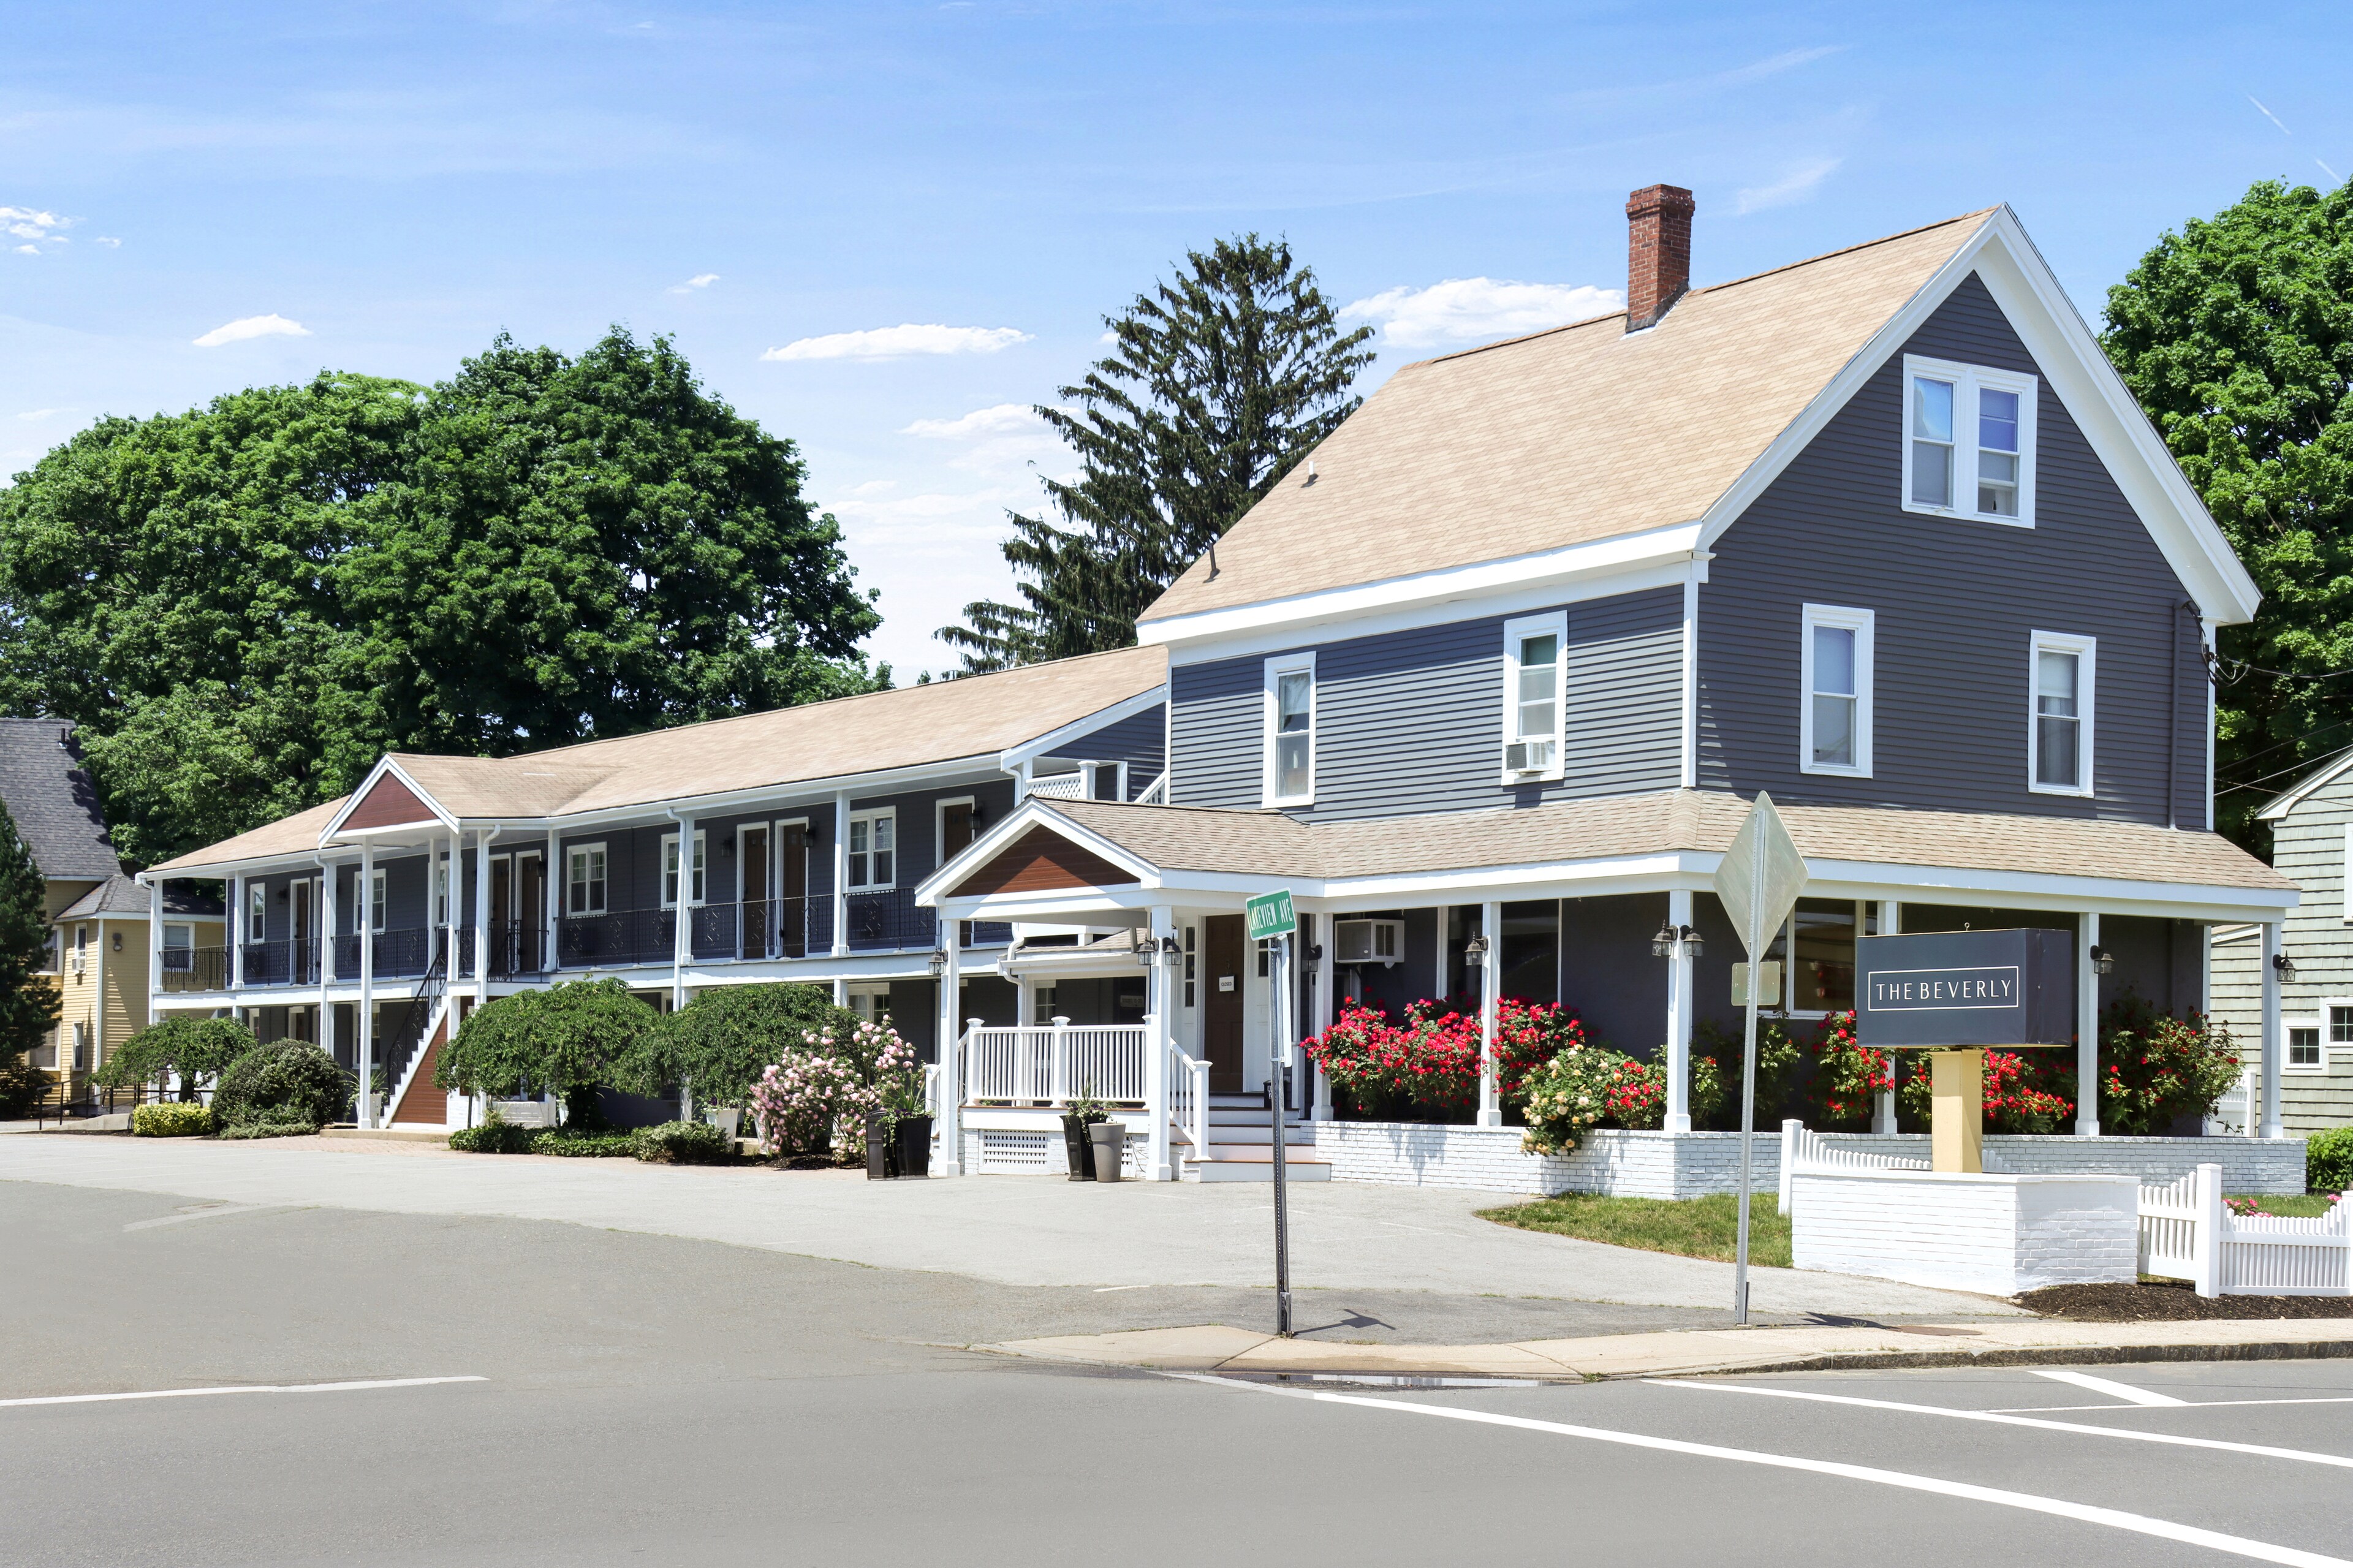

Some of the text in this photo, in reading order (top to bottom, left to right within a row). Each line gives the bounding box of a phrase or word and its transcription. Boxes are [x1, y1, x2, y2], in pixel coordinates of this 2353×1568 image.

[1248, 898, 1292, 931] LAKEVIEW AVE
[1876, 980, 2011, 1000] THE BEVERLY
